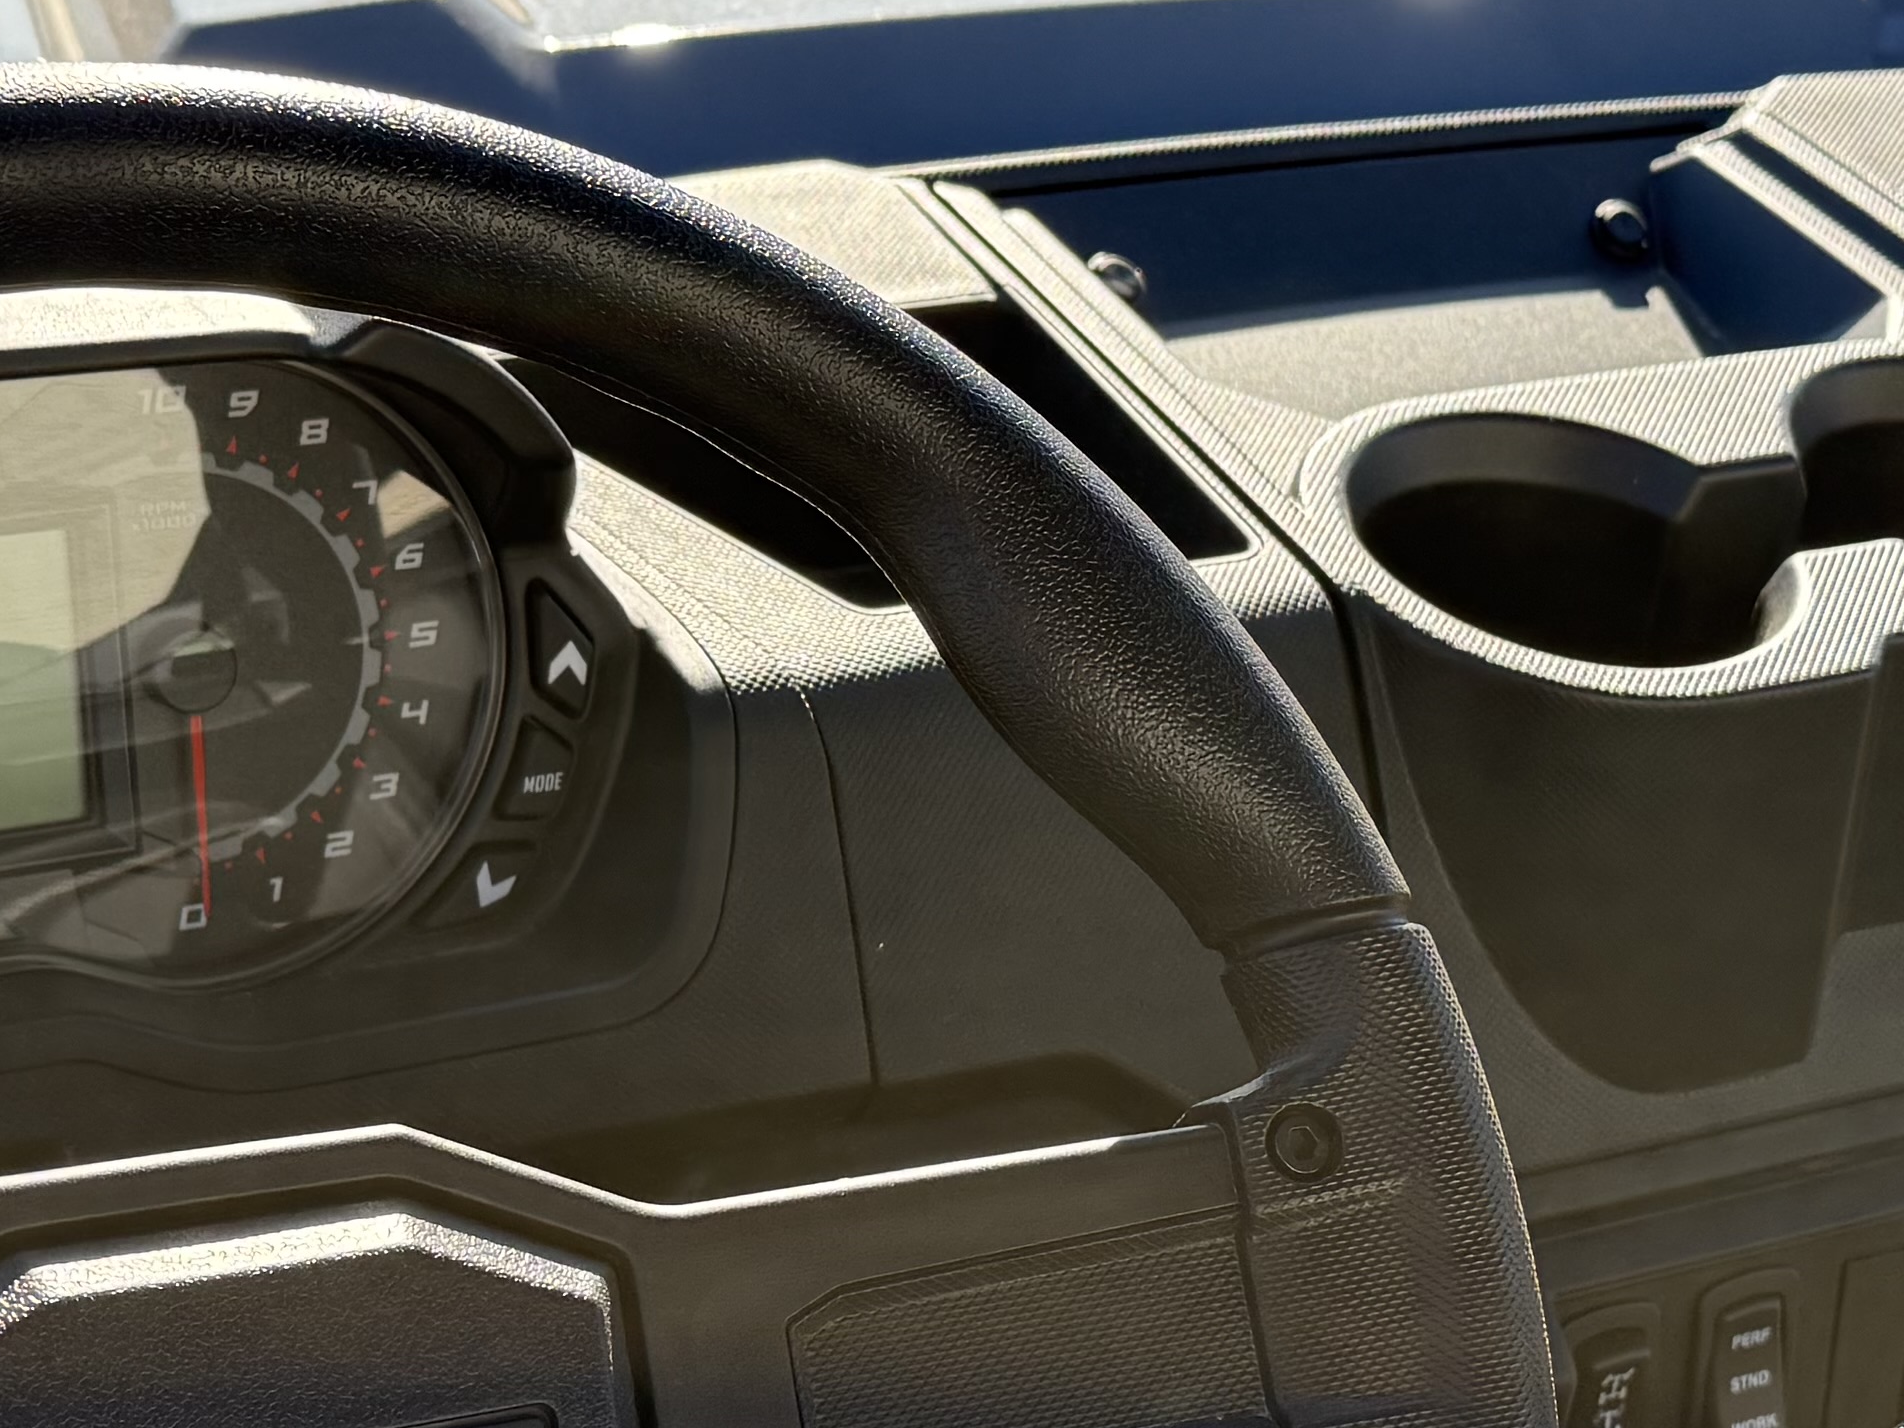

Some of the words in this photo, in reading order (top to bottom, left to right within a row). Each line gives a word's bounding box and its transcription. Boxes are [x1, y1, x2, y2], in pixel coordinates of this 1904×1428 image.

[138, 385, 186, 414] 10
[228, 390, 259, 418] 9
[300, 418, 329, 446] 8
[352, 479, 377, 505] 7
[395, 542, 424, 570] 6
[409, 620, 439, 648] 5
[401, 699, 429, 725] 4
[369, 772, 399, 800] 3
[523, 772, 563, 794] MODE
[324, 830, 354, 858] 2
[269, 876, 283, 903] 1
[179, 903, 208, 930] 0
[1731, 1326, 1773, 1351] PERF
[1730, 1369, 1772, 1395] STND
